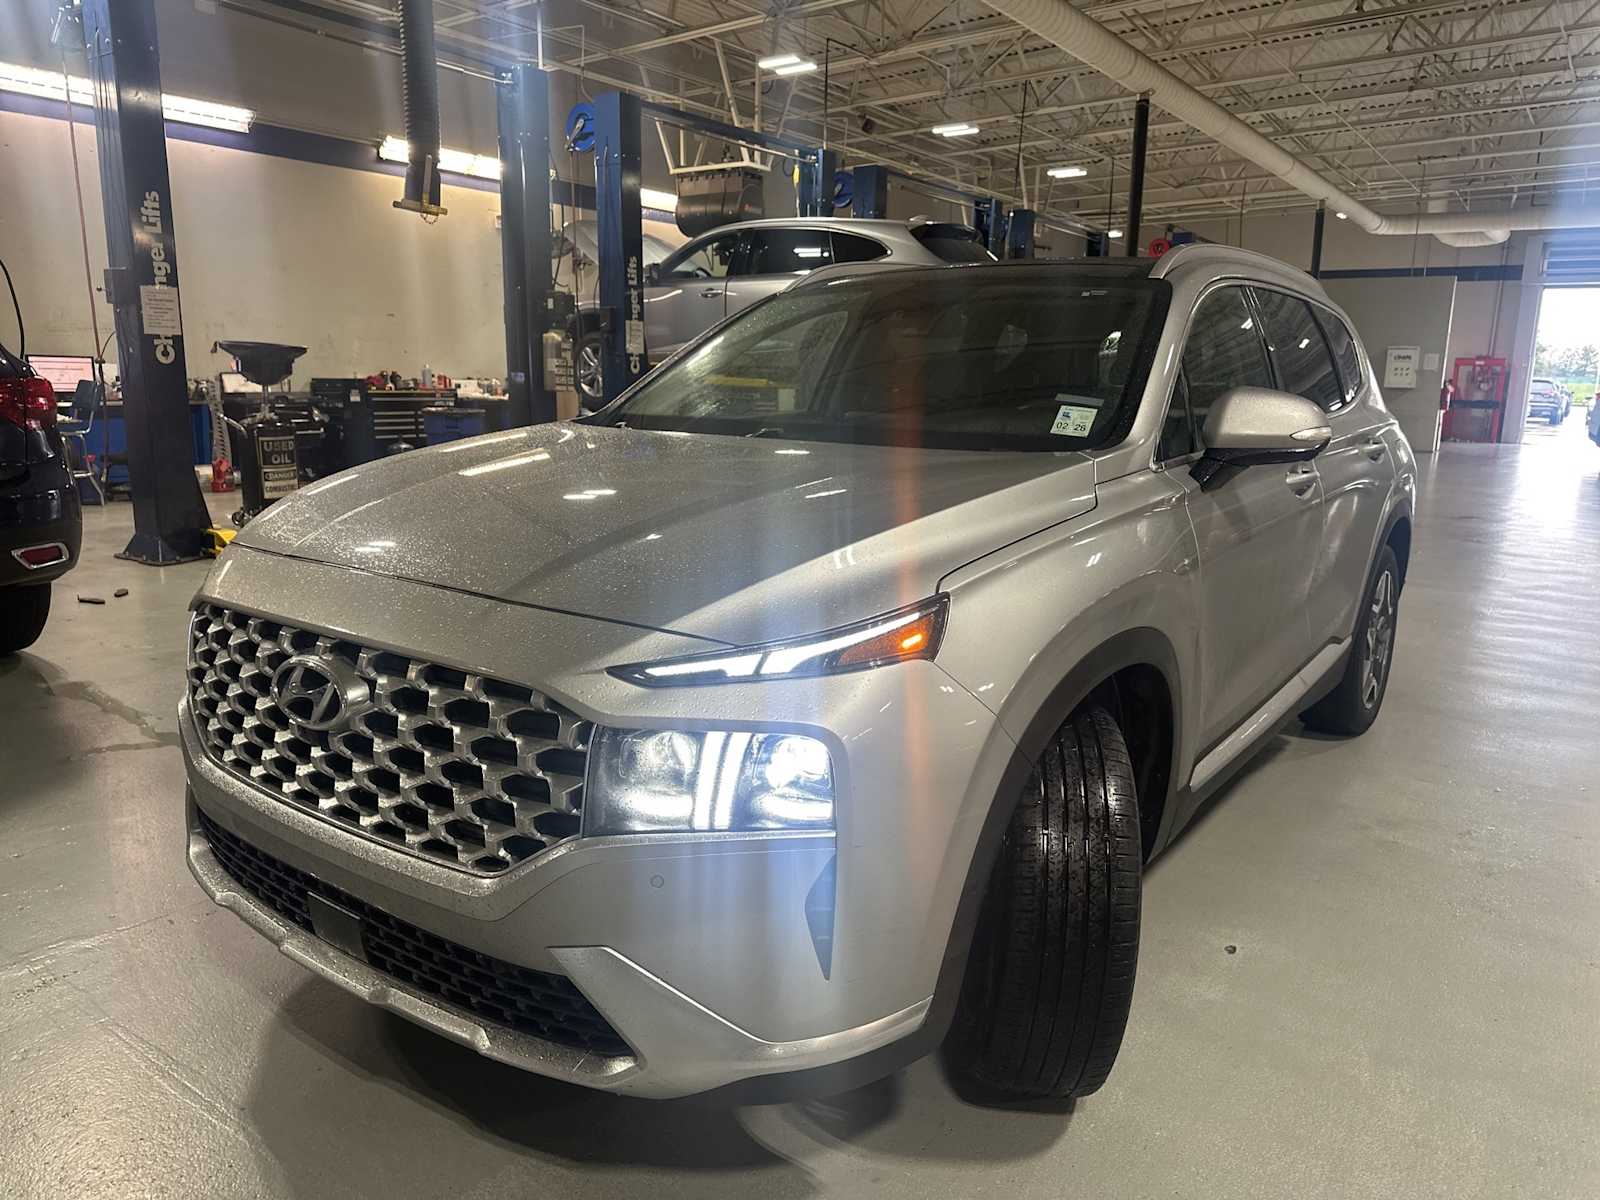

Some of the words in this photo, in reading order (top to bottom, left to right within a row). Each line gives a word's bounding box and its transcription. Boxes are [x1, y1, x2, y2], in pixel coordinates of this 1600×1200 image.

[140, 191, 162, 234] Lifts
[627, 255, 638, 286] Lifts
[150, 239, 175, 365] Chnger
[1056, 421, 1069, 430] 02
[263, 440, 294, 451] USED
[271, 453, 291, 464] OIL
